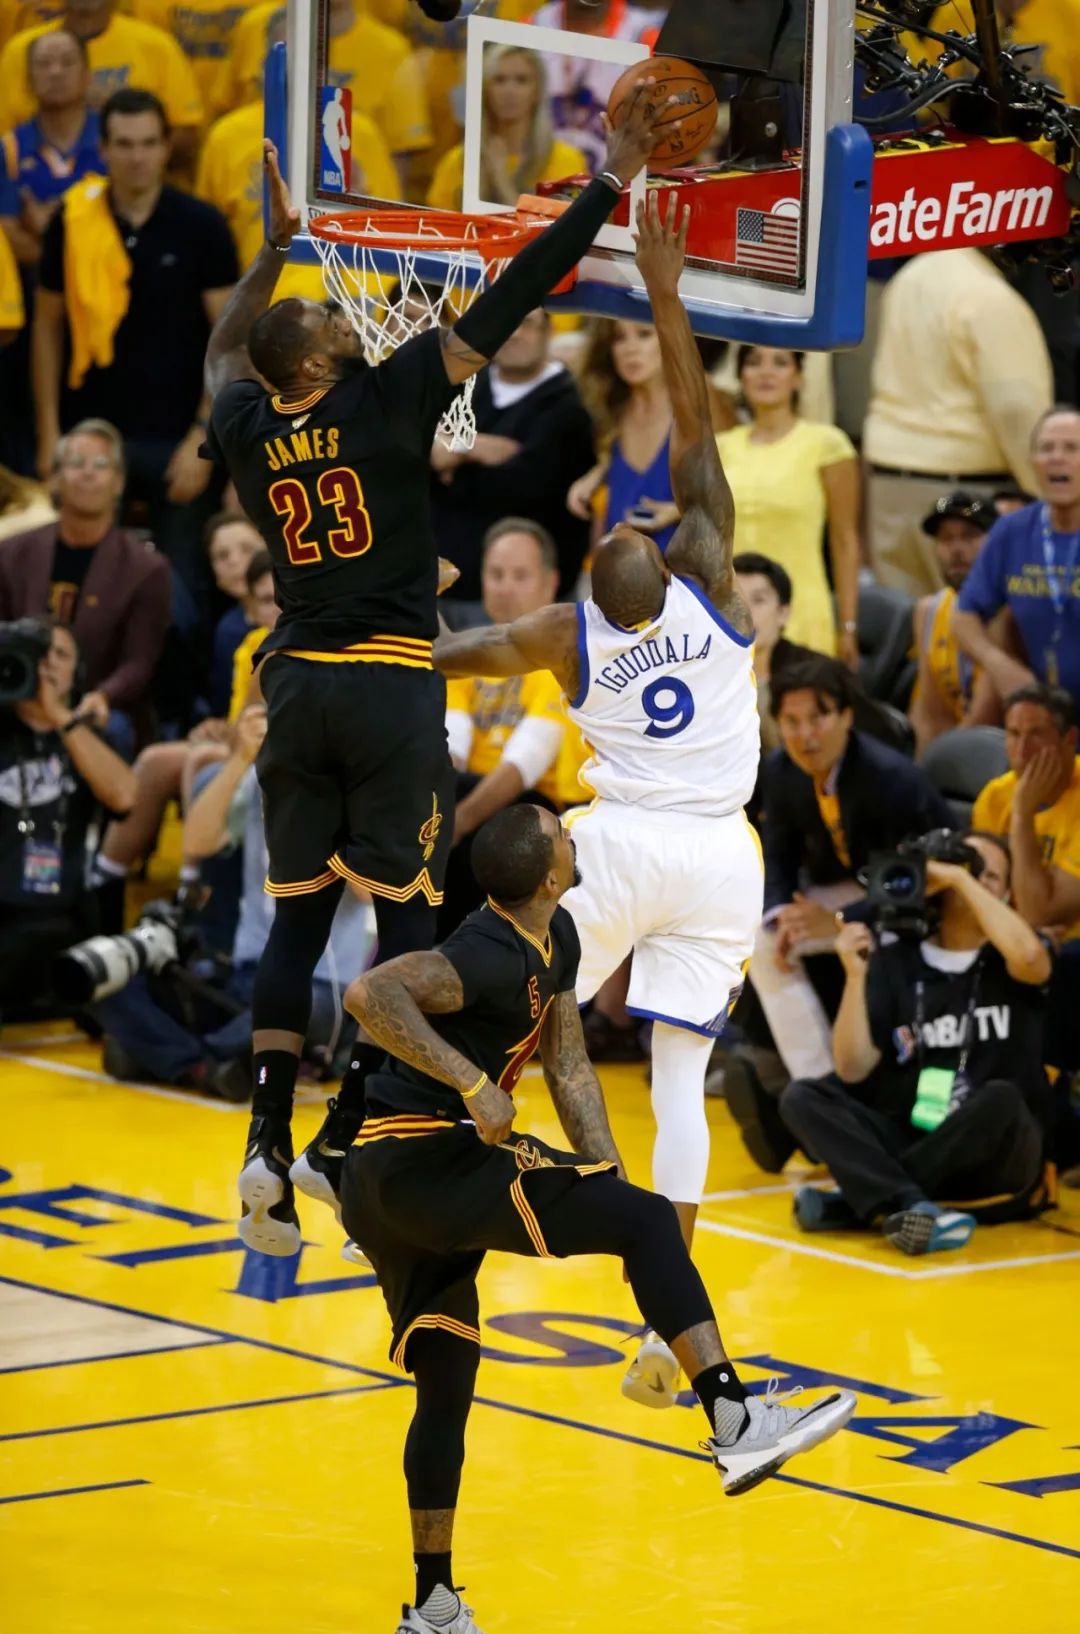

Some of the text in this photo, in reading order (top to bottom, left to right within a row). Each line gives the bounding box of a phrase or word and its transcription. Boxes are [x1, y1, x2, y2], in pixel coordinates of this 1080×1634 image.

[323, 169, 341, 187] NBA
[869, 180, 1053, 247] ateFarm
[264, 427, 340, 471] JAMES
[268, 466, 373, 565] 23
[594, 633, 712, 695] IGUODALA
[641, 675, 695, 739] 9
[527, 975, 541, 1019] 5
[973, 1004, 1010, 1042] TV
